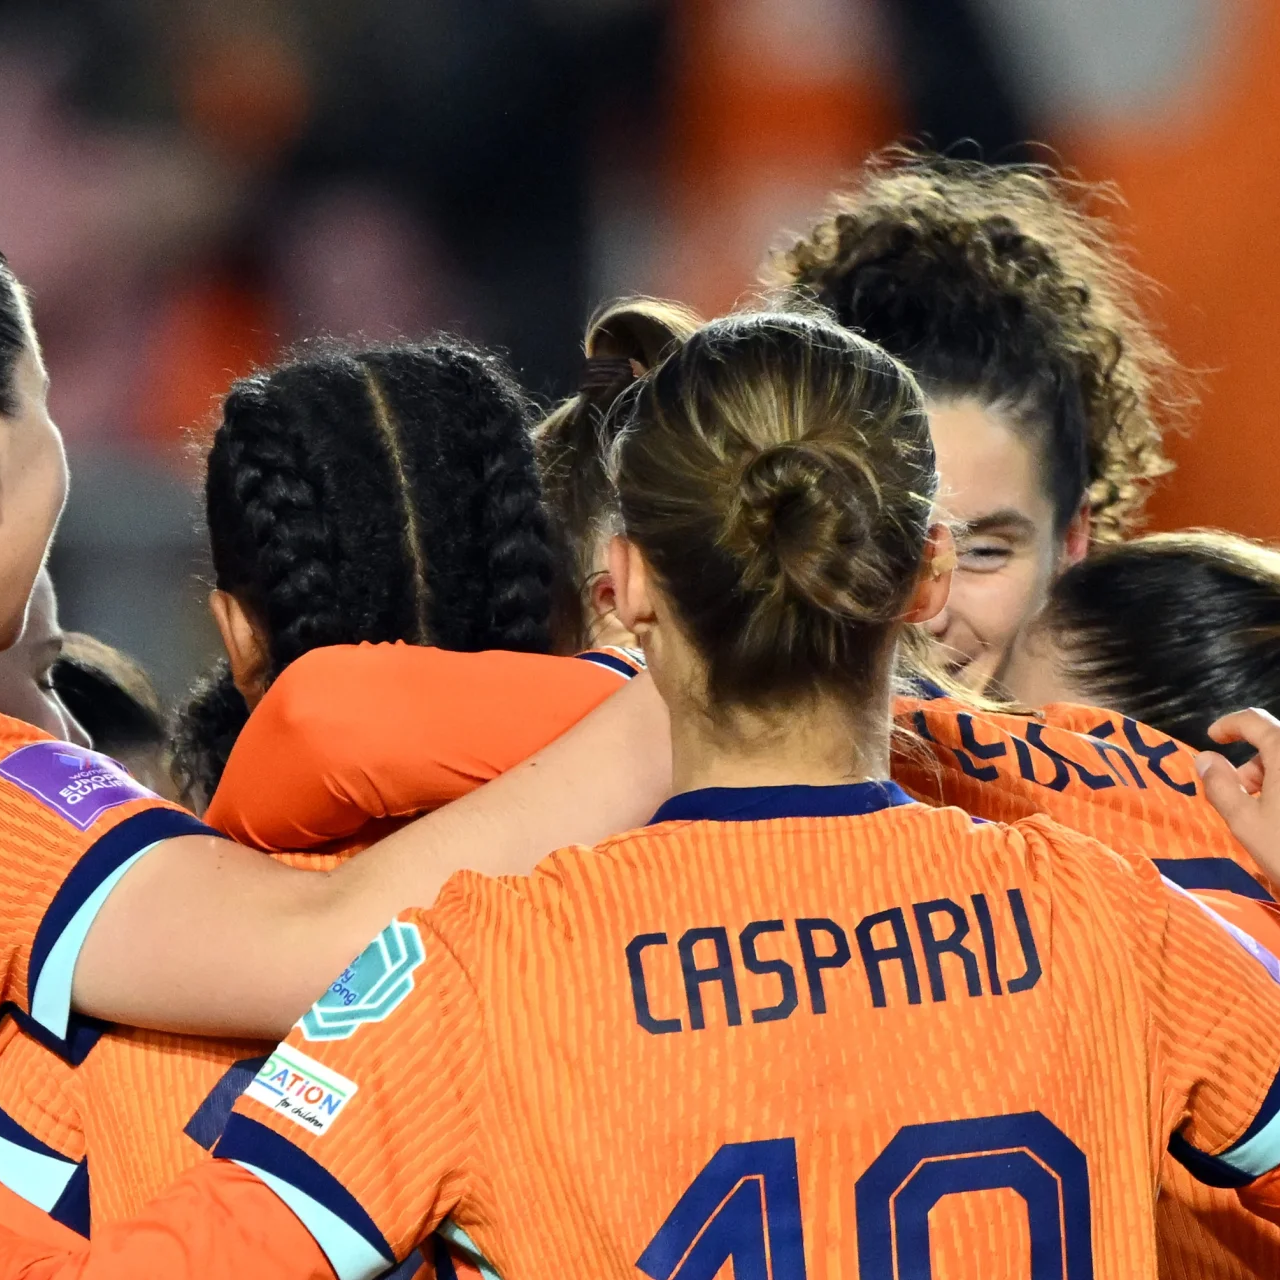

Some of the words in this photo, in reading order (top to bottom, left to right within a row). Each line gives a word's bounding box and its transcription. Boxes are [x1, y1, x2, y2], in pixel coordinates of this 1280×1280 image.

[624, 887, 1043, 1036] CASPARIJ
[275, 1096, 293, 1108] for
[290, 1106, 324, 1129] children
